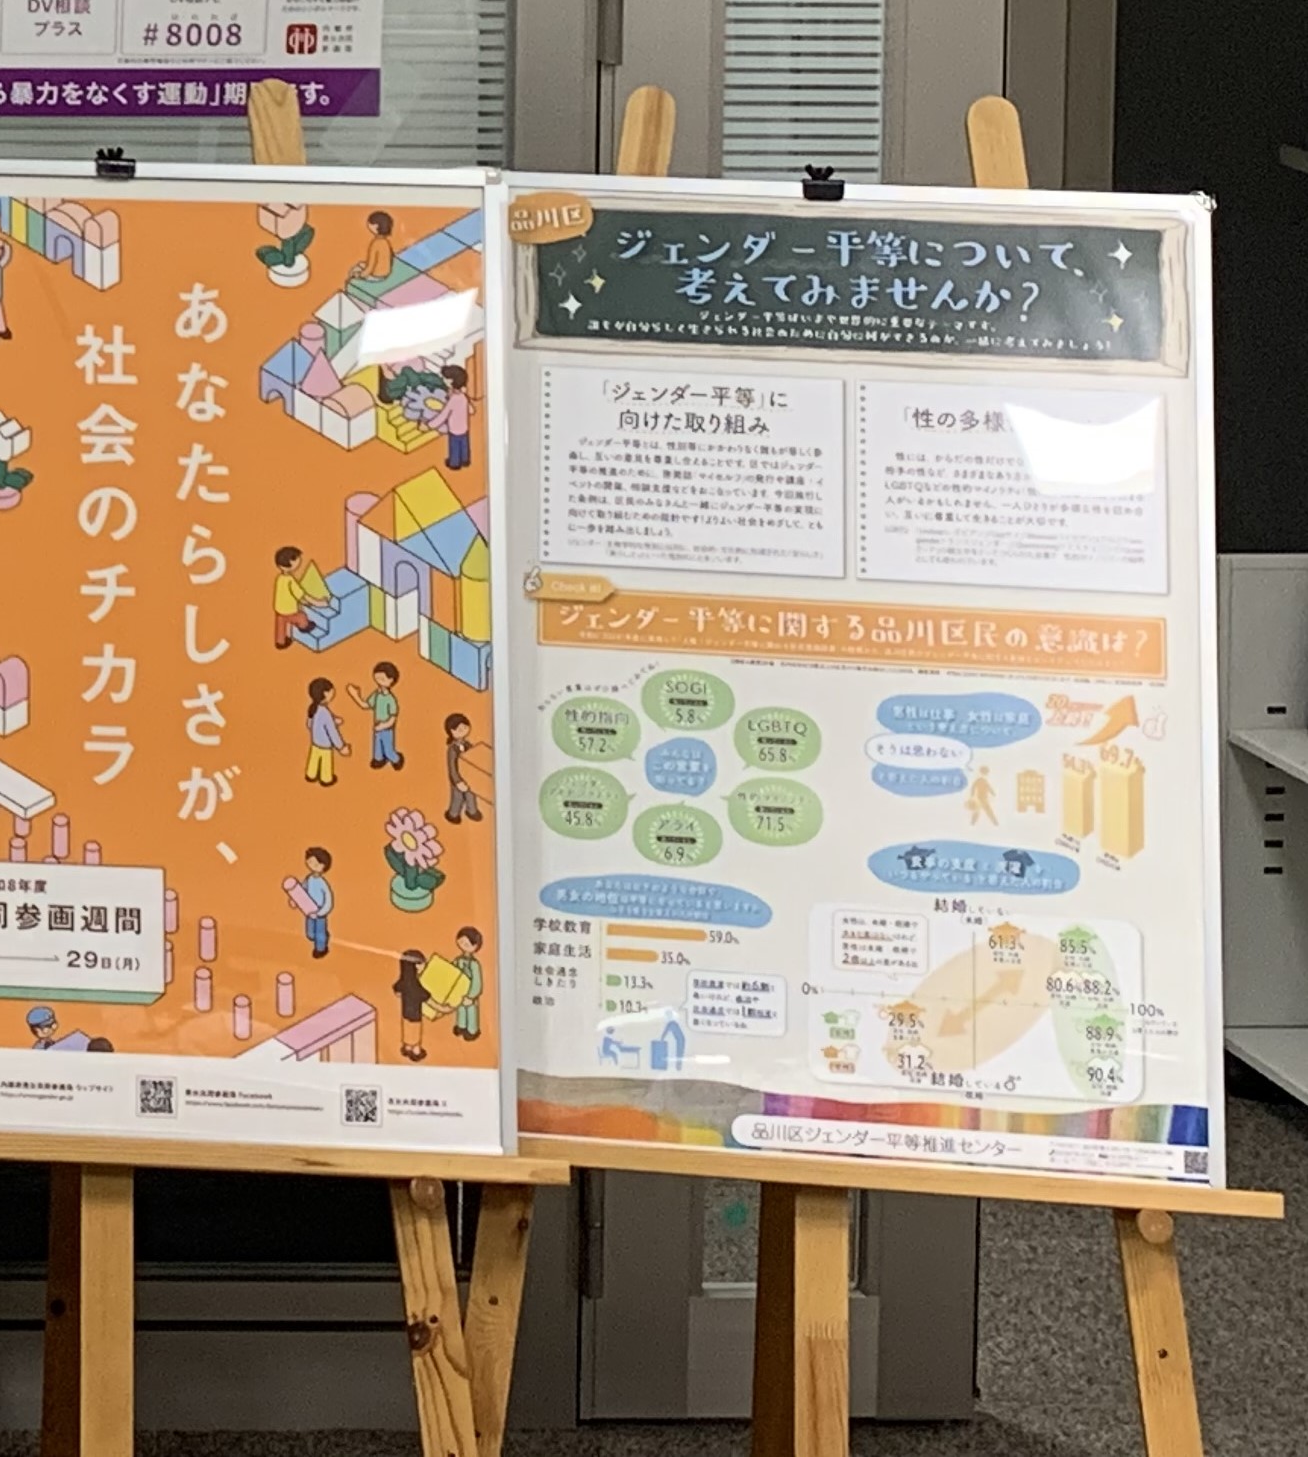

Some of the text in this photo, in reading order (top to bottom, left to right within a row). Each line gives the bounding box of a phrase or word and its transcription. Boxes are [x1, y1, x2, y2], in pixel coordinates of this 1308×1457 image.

[35, 21, 83, 37] プラス
[143, 23, 242, 47] #8008
[511, 204, 584, 232] 品川区
[617, 229, 1084, 277] ジェンダー平等について、
[676, 267, 1039, 322] 考えてみませんか？
[619, 409, 770, 434] 向けた取り組み
[903, 407, 1014, 433] 「性の多様
[74, 325, 140, 786] 社会のチカラ
[174, 282, 239, 866] あなたらしさが、
[559, 604, 1150, 659] ジェンダー平等に関する品川区民の意識は？
[747, 719, 808, 735] LGBTQ
[534, 918, 592, 935] 学校教育
[533, 942, 592, 959] 家庭生活
[751, 1121, 1023, 1158] 品川区ジェンダー平等推進センター
